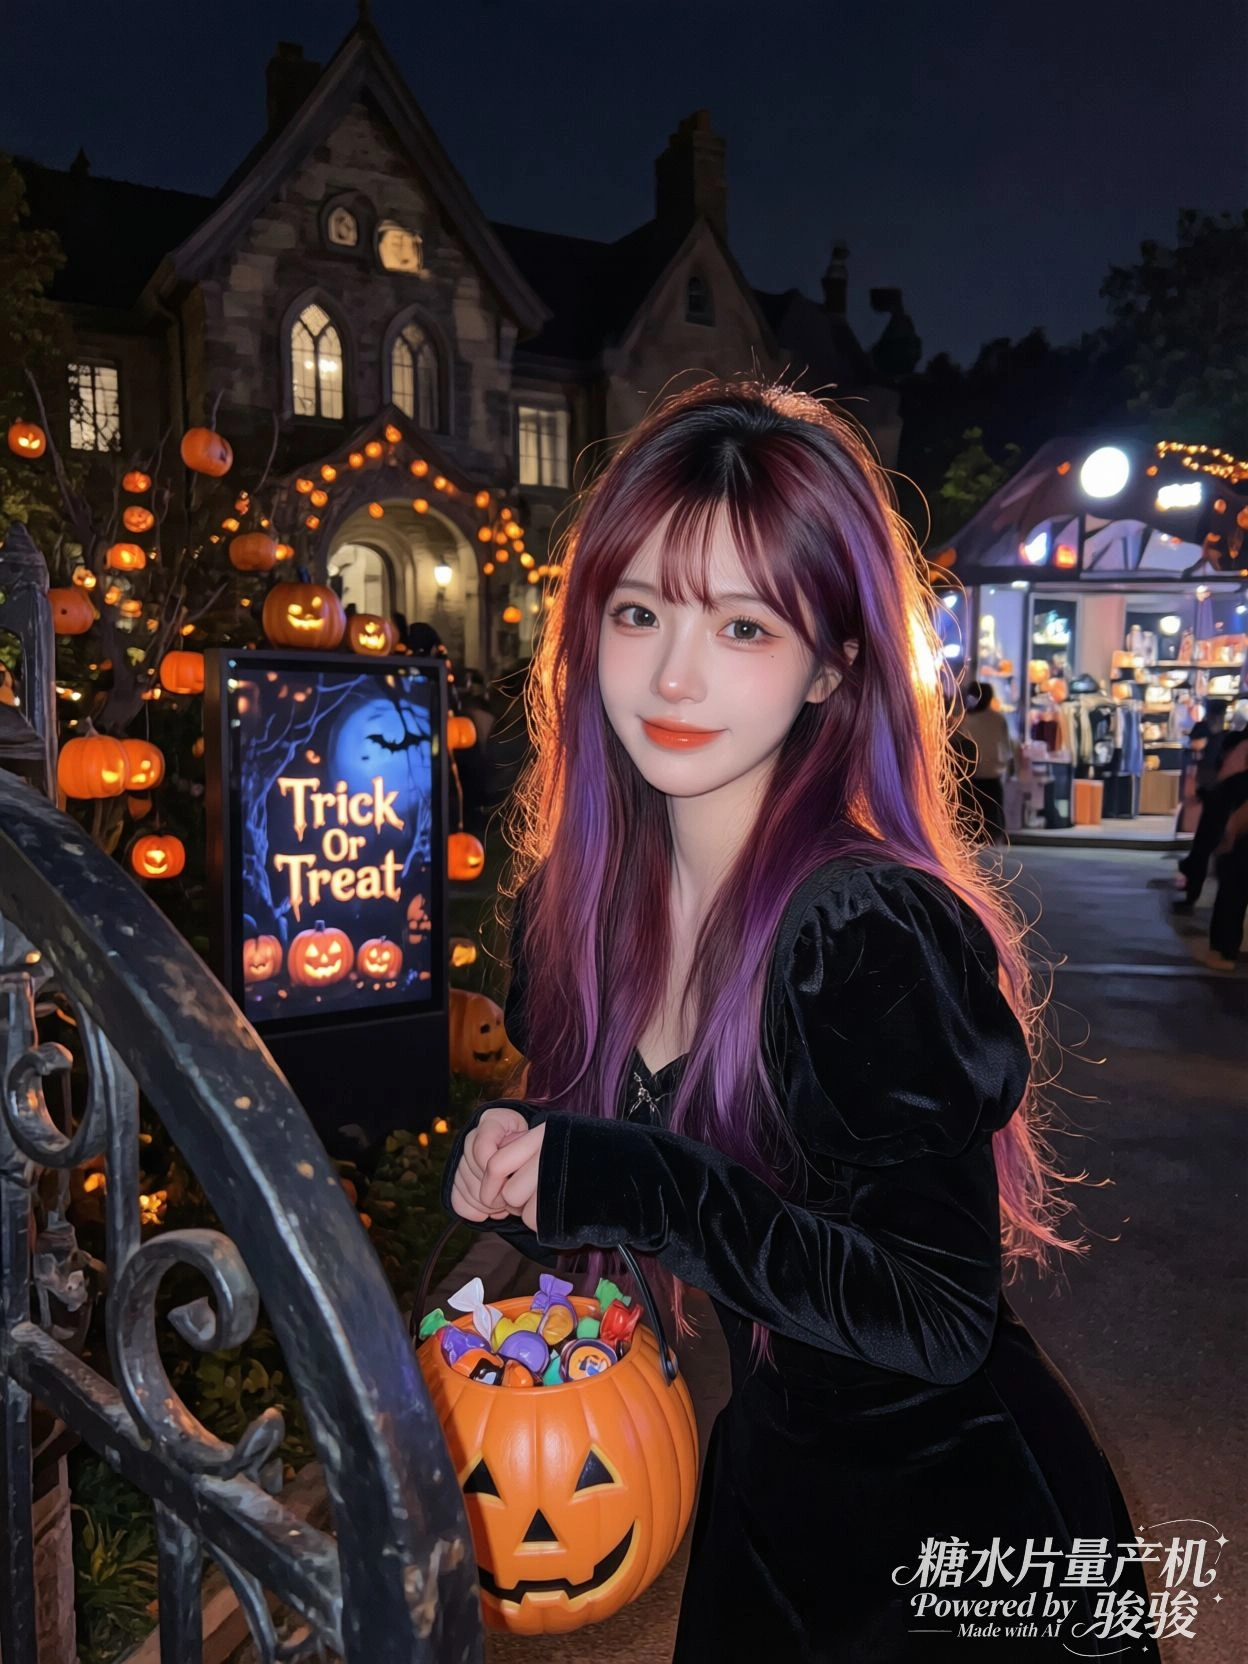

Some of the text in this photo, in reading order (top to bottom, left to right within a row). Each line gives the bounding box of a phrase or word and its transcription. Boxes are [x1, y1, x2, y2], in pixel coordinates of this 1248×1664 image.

[277, 775, 404, 842] Trick
[322, 828, 366, 862] Or
[274, 849, 404, 922] Treat
